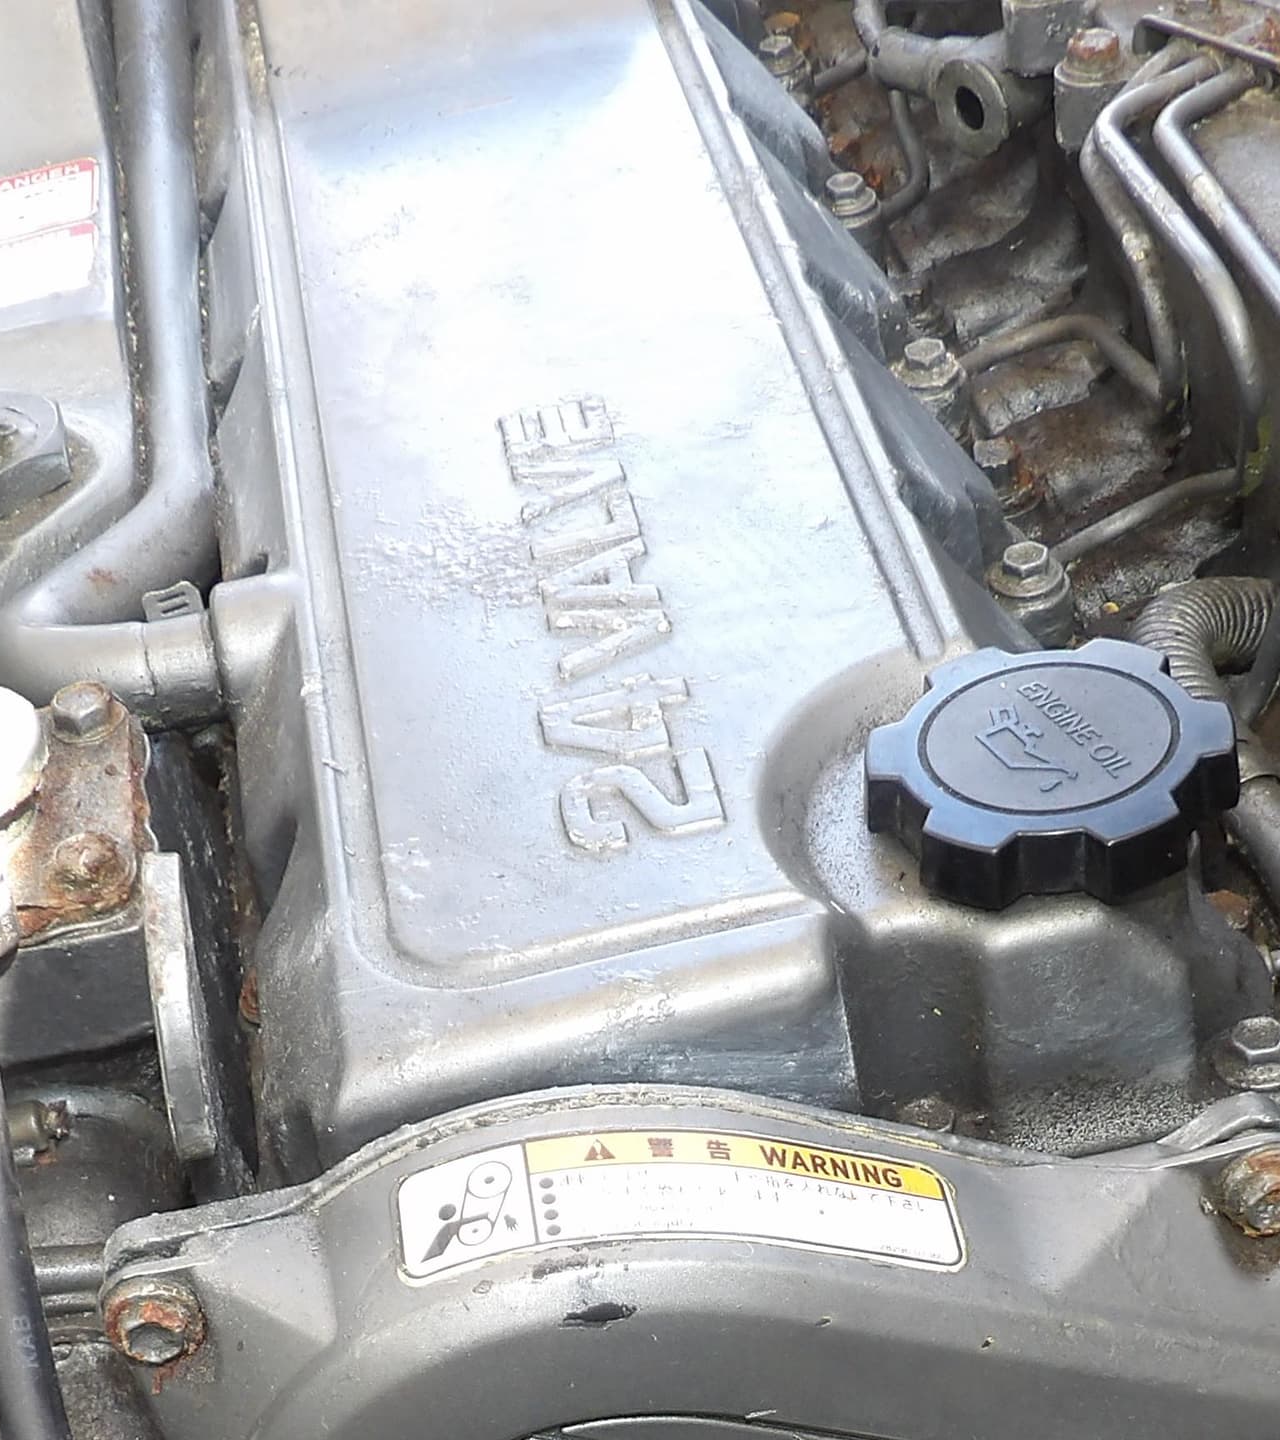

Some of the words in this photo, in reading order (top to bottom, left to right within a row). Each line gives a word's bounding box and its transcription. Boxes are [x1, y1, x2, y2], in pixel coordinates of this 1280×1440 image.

[1017, 680, 1101, 746] ENGINE
[1089, 740, 1133, 779] OIL
[647, 1137, 731, 1161] 警告
[759, 1144, 903, 1188] WARNING
